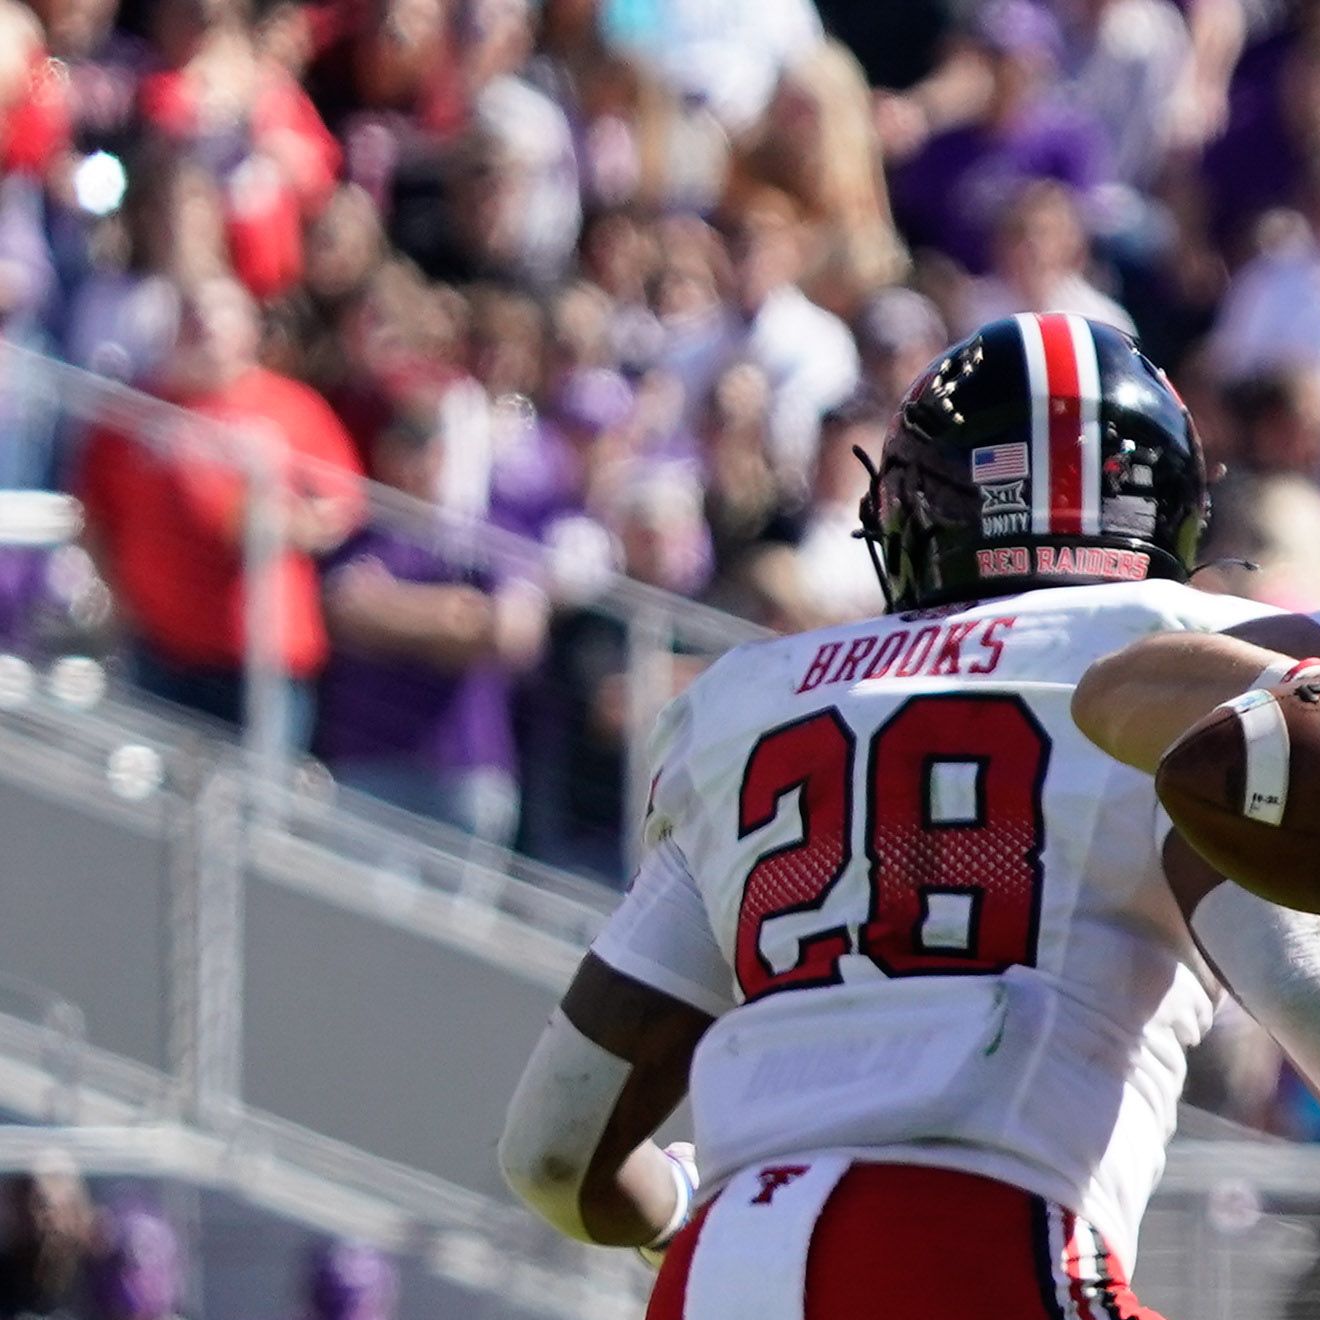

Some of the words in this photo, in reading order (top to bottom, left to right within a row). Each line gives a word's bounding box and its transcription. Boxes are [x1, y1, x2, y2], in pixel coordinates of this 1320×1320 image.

[976, 547, 1031, 578] RED
[1036, 546, 1151, 581] RAIDERS
[795, 615, 1017, 695] BROOKS
[735, 690, 1053, 1007] 28
